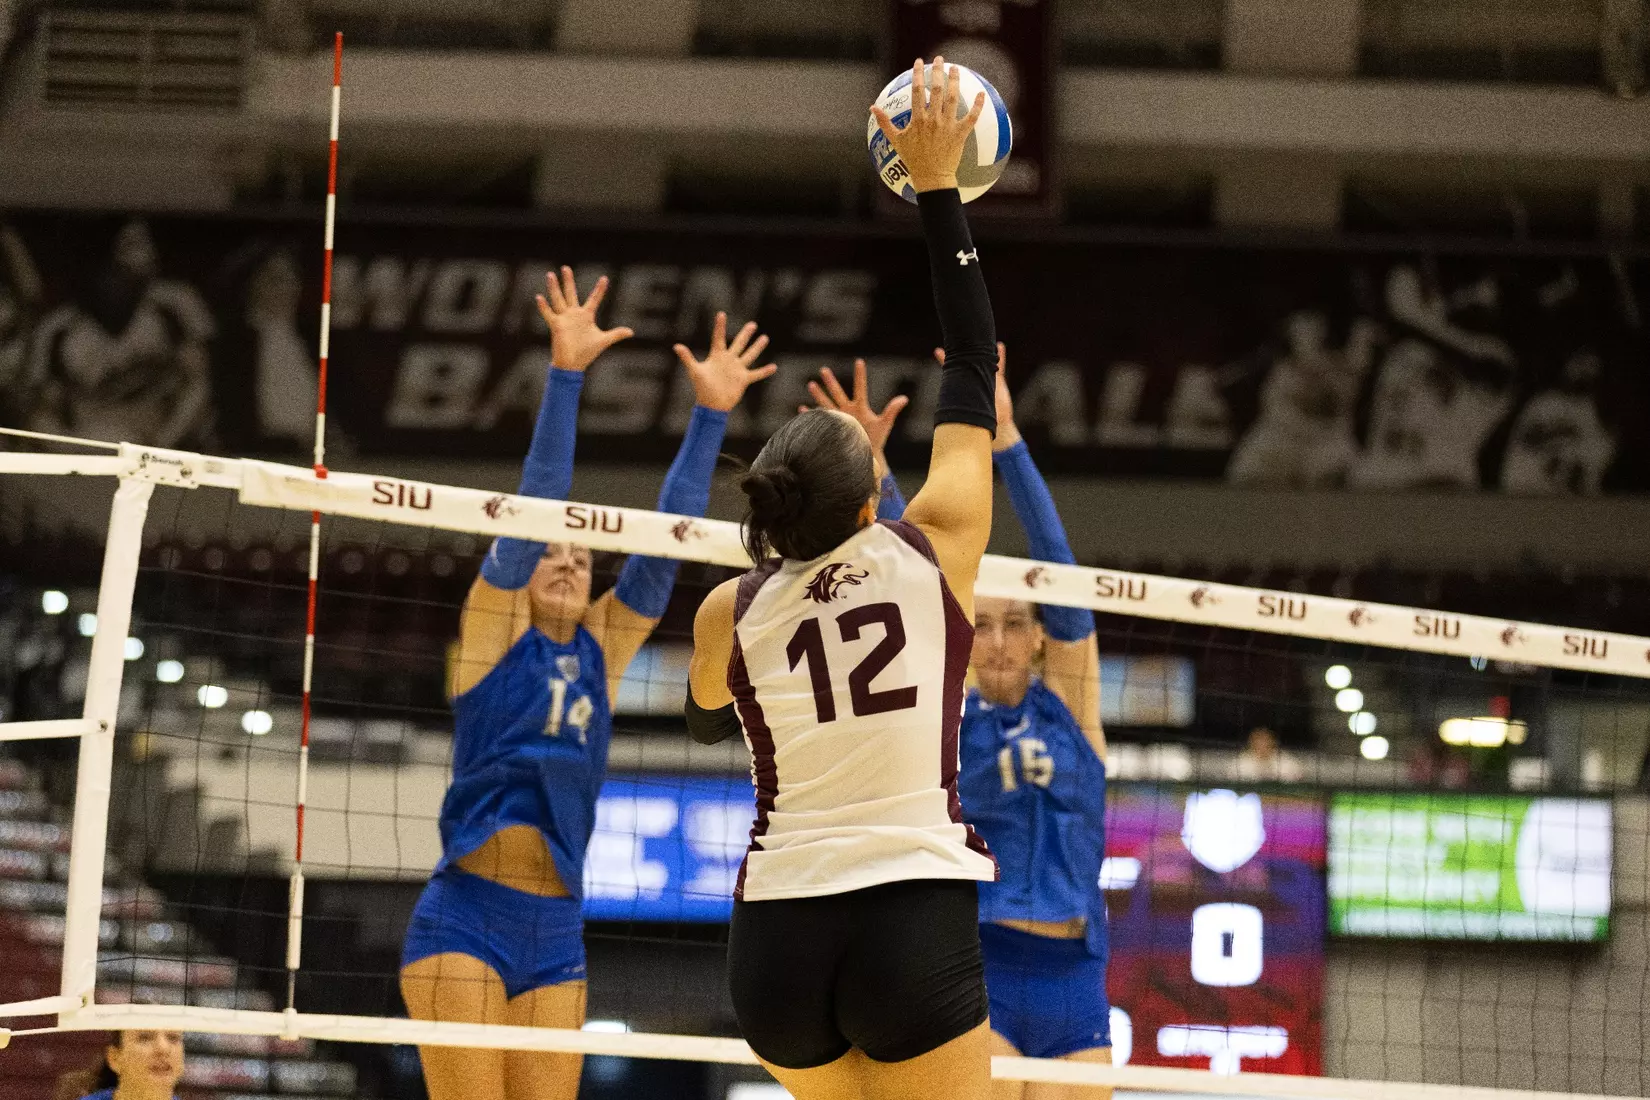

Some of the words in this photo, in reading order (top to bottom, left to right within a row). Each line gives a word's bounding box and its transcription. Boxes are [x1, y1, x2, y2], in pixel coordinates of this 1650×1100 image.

[882, 159, 910, 186] lten
[383, 343, 1236, 448] BASETALL
[372, 480, 433, 510] SIU
[564, 506, 624, 534] SIU
[1096, 575, 1147, 601] SIU
[1257, 594, 1307, 620] SIU
[1413, 614, 1461, 640] SIU
[1562, 633, 1608, 659] SIU
[786, 602, 918, 724] 12
